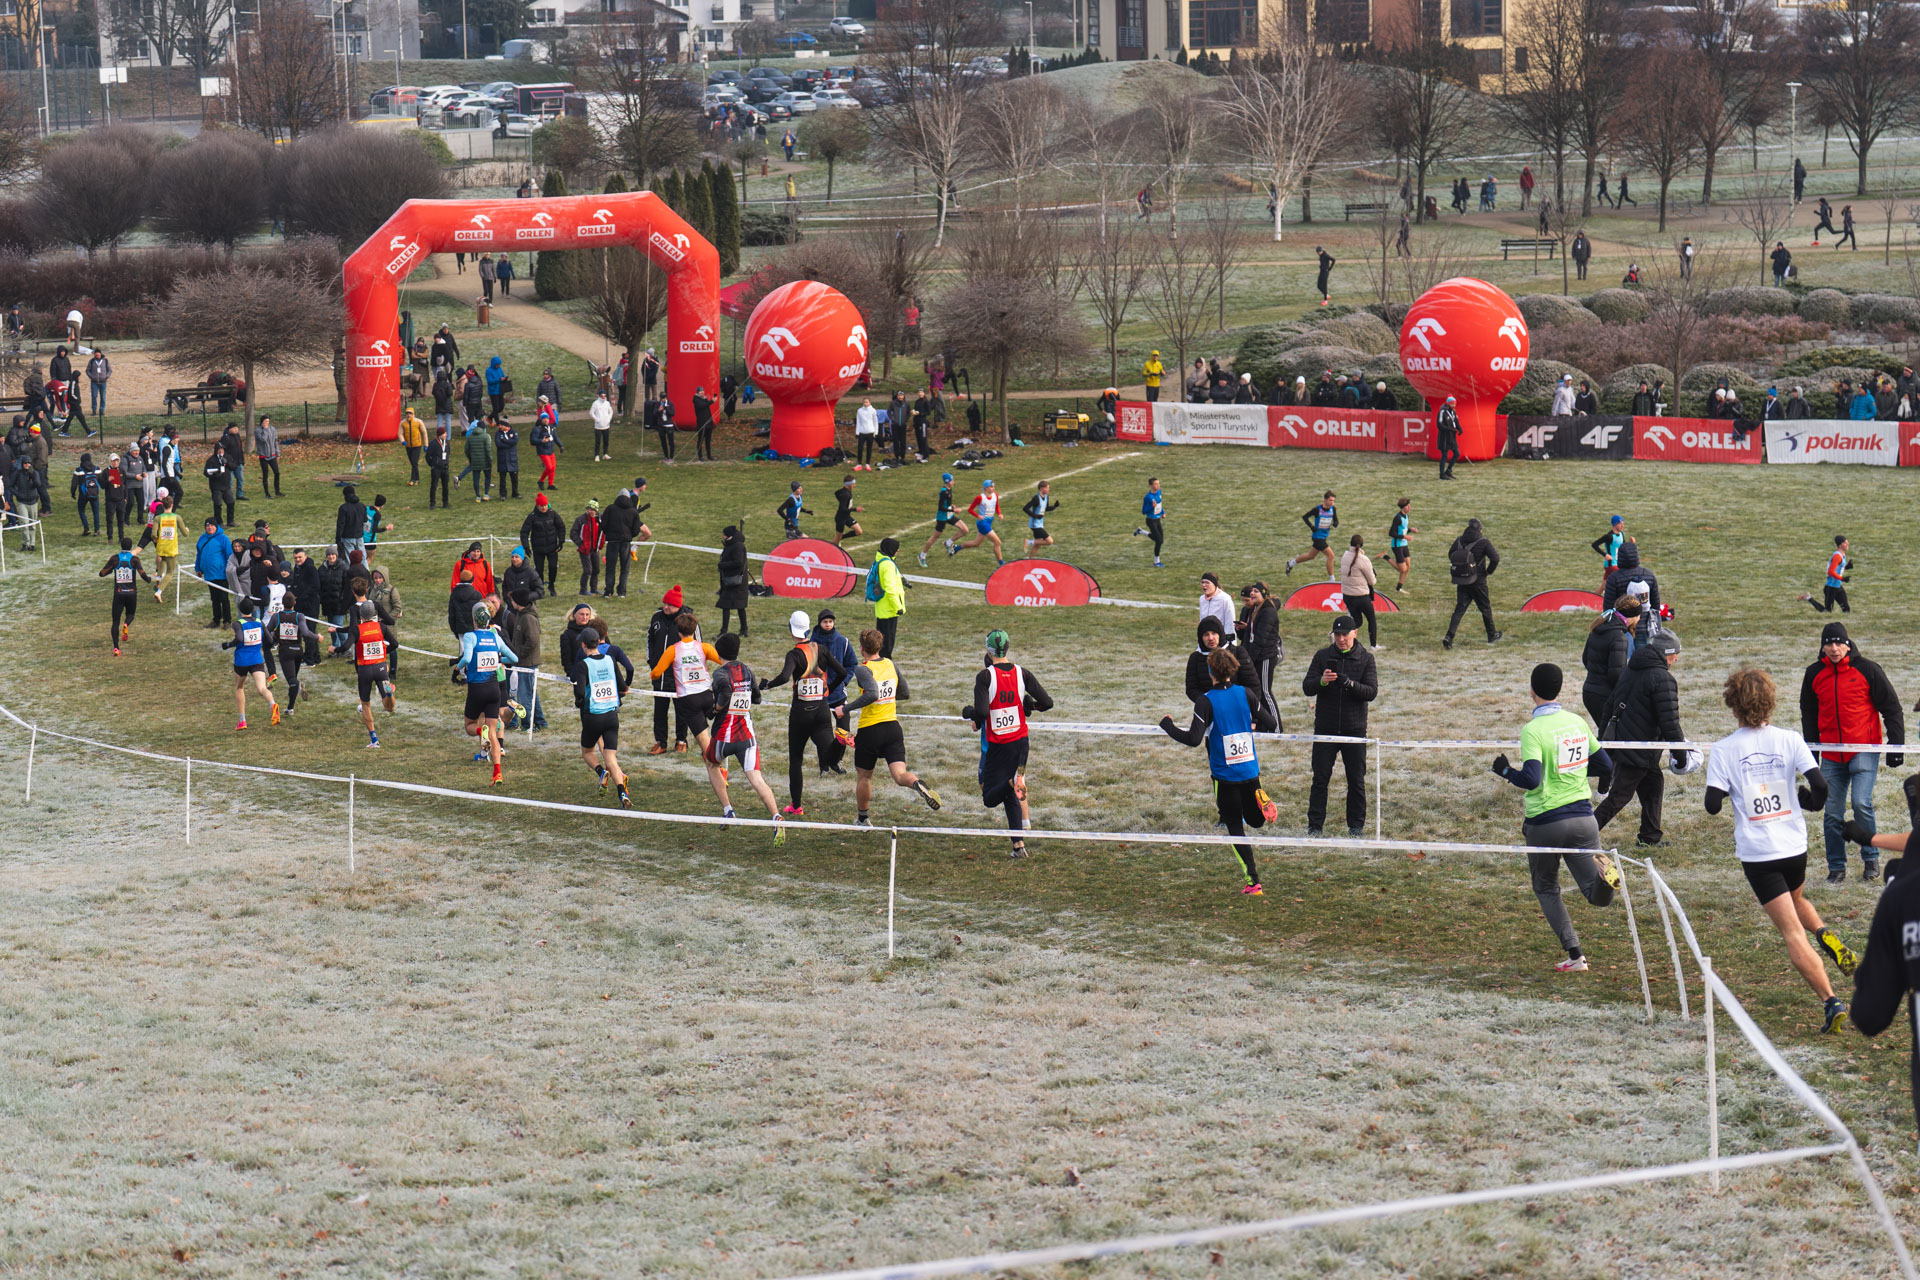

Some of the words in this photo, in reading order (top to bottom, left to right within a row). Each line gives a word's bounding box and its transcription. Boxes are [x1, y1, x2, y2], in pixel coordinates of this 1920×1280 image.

[457, 232, 491, 240] ORLEN
[518, 229, 552, 238] ORLEN
[579, 226, 613, 235] ORLEN
[653, 235, 682, 260] ORLEN
[390, 245, 418, 273] ORLEN
[682, 342, 712, 351] ORLEN
[358, 357, 390, 366] ORLEN
[1407, 357, 1451, 371] ORLEN
[756, 362, 804, 379] ORLEN
[1190, 412, 1241, 420] Ministerstwo
[1123, 423, 1145, 433] PZLA
[1191, 421, 1217, 431] Sportu
[1218, 422, 1222, 430] i
[1223, 422, 1258, 431] Turystyki
[1313, 419, 1376, 438] ORLEN
[1517, 425, 1559, 448] 4F
[1580, 425, 1623, 449] 4F
[1682, 431, 1751, 451] ORLEN
[1805, 432, 1884, 454] polanik
[118, 572, 130, 580] 516
[786, 576, 822, 589] ORLEN
[1014, 595, 1056, 607] ORLEN
[249, 633, 258, 642] 93
[284, 627, 294, 636] 63
[366, 645, 381, 656] 538
[481, 657, 496, 667] 370
[688, 671, 700, 681] 53
[595, 687, 612, 698] 698
[802, 684, 818, 695] 511
[879, 686, 893, 699] 169
[1000, 690, 1015, 704] 80
[733, 698, 749, 710] 420
[996, 715, 1014, 728] 509
[1230, 742, 1248, 756] 366
[1568, 746, 1582, 762] 75
[1753, 794, 1782, 815] 803
